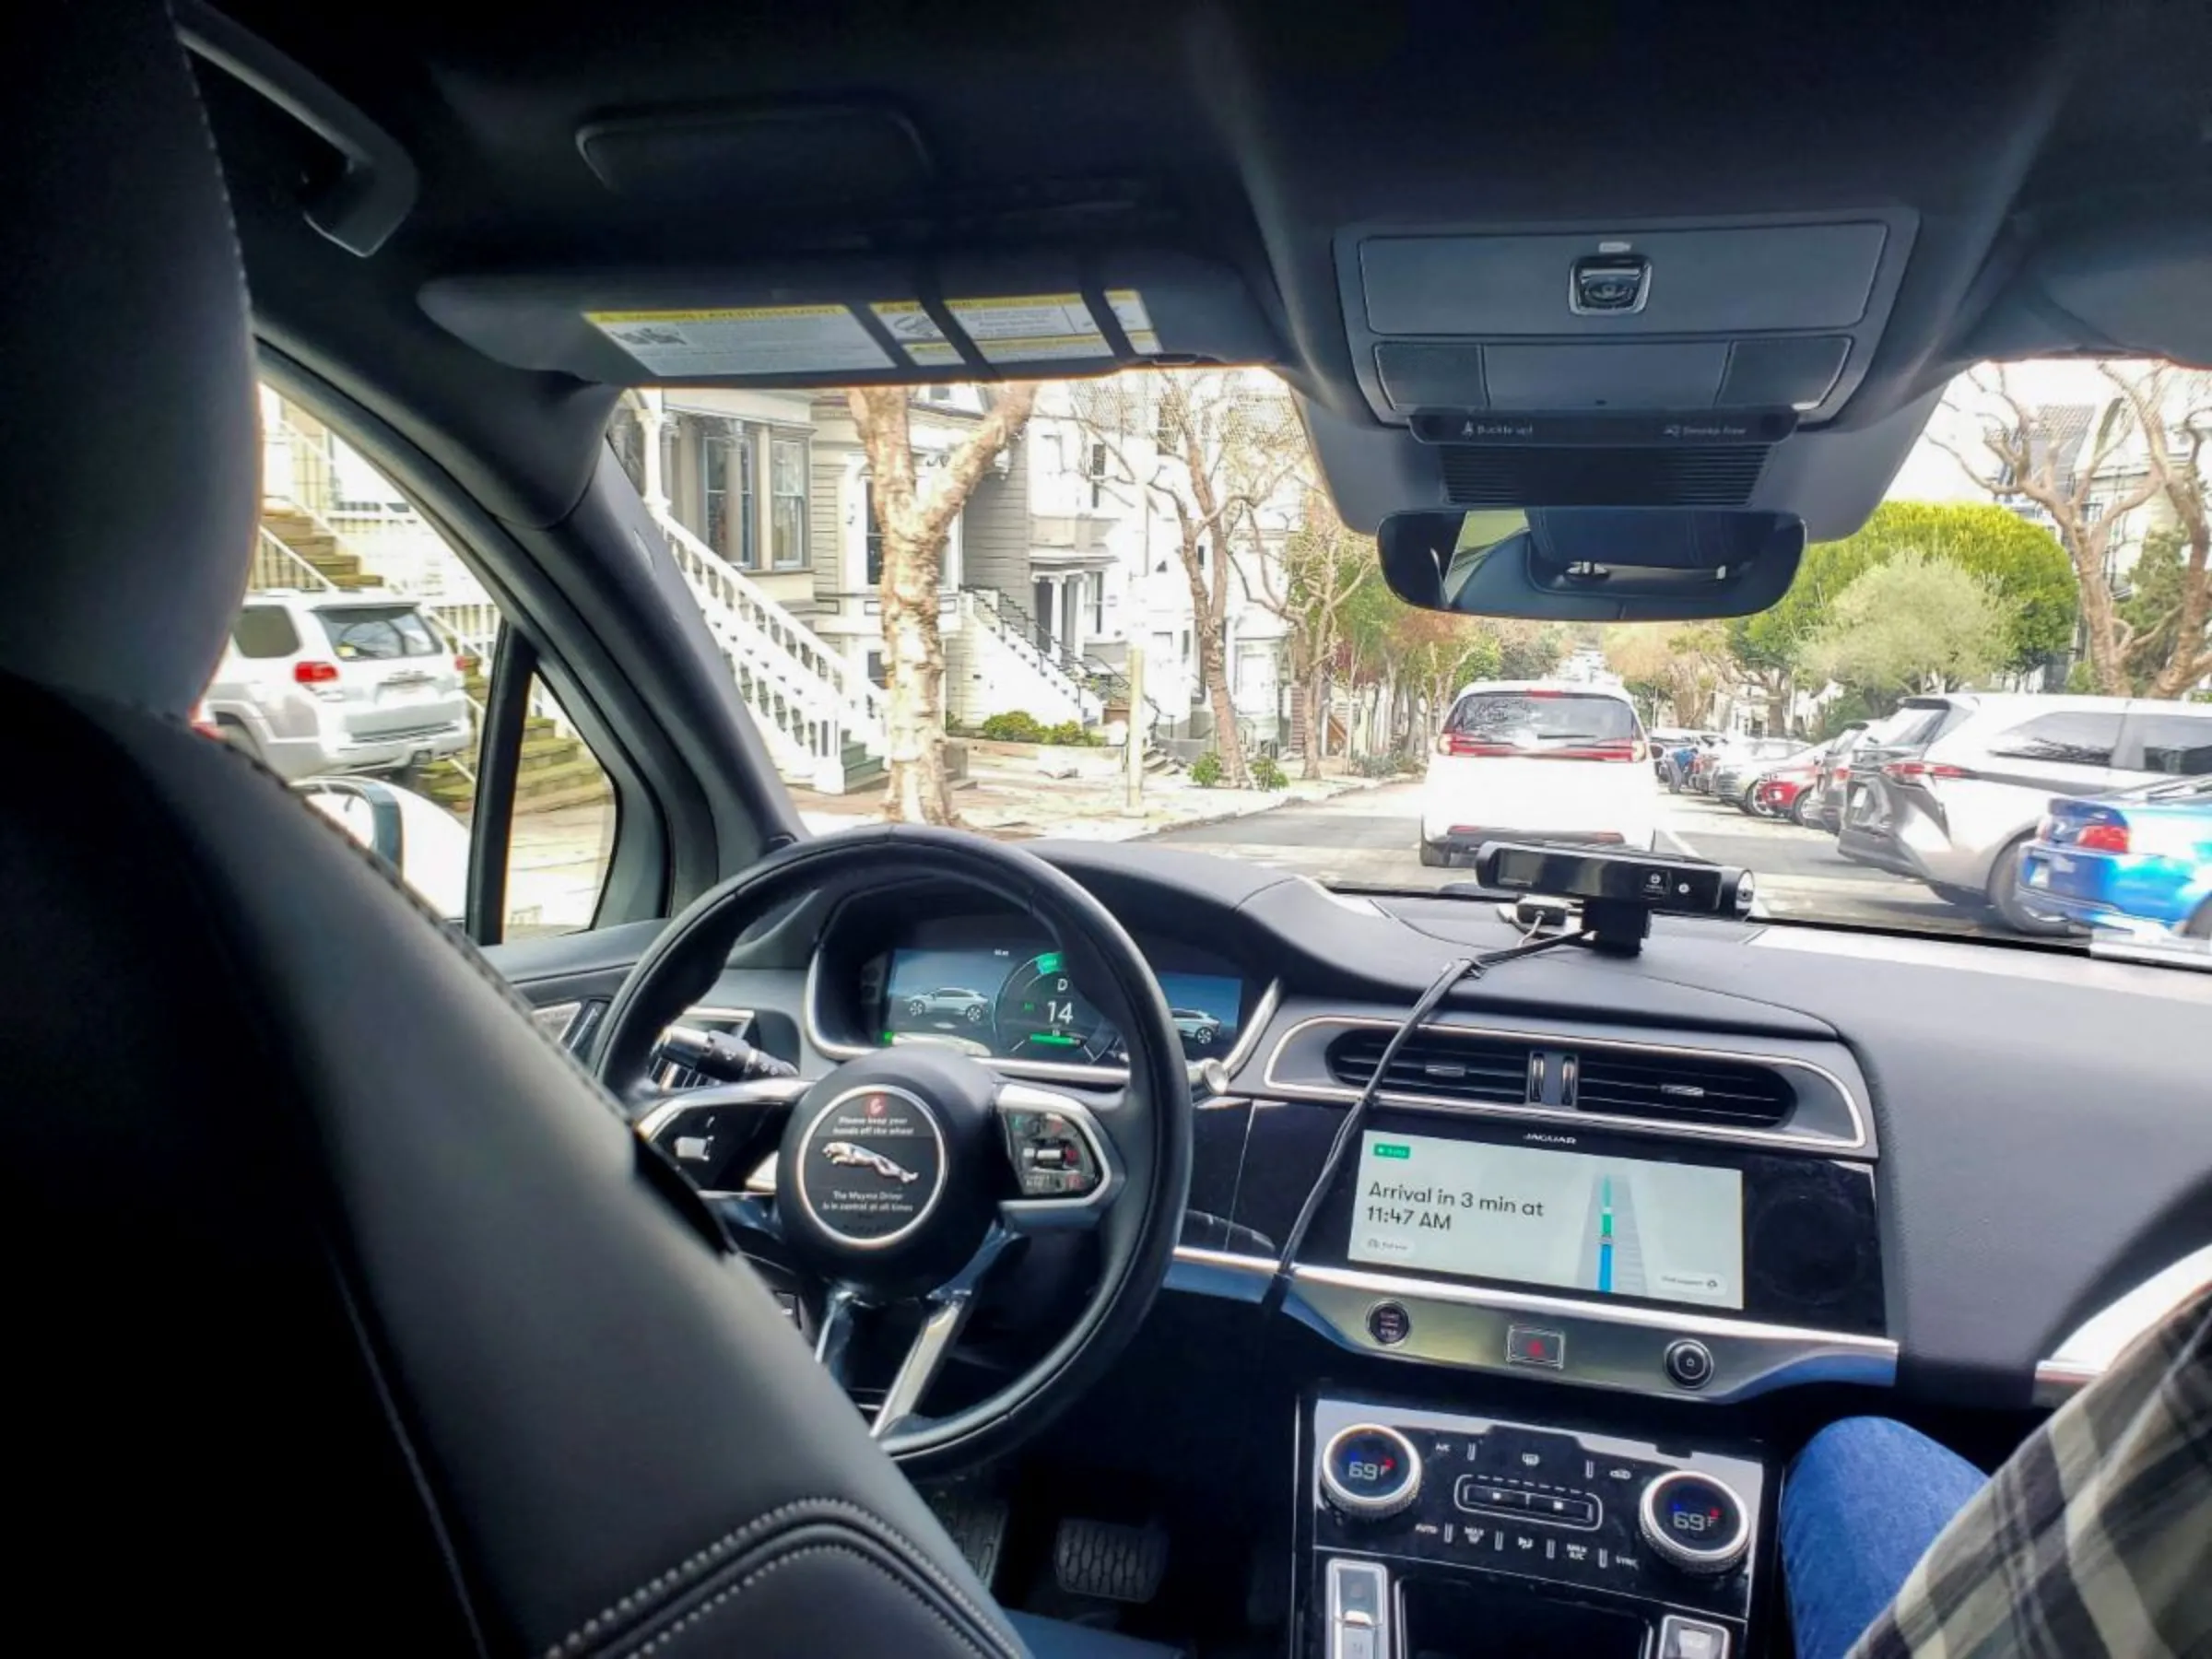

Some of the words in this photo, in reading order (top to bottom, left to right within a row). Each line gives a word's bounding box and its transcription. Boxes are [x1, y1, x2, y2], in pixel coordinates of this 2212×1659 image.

[1056, 978, 1068, 992] D
[1047, 1000, 1074, 1024] 14
[1523, 1133, 1577, 1145] JAGUAR
[1368, 1182, 1433, 1204] Arrival
[1437, 1189, 1455, 1206] in
[1460, 1192, 1474, 1208] 3
[1478, 1195, 1517, 1214] min
[1522, 1202, 1545, 1218] at
[1368, 1205, 1415, 1226] 11:47
[1418, 1212, 1452, 1231] AM
